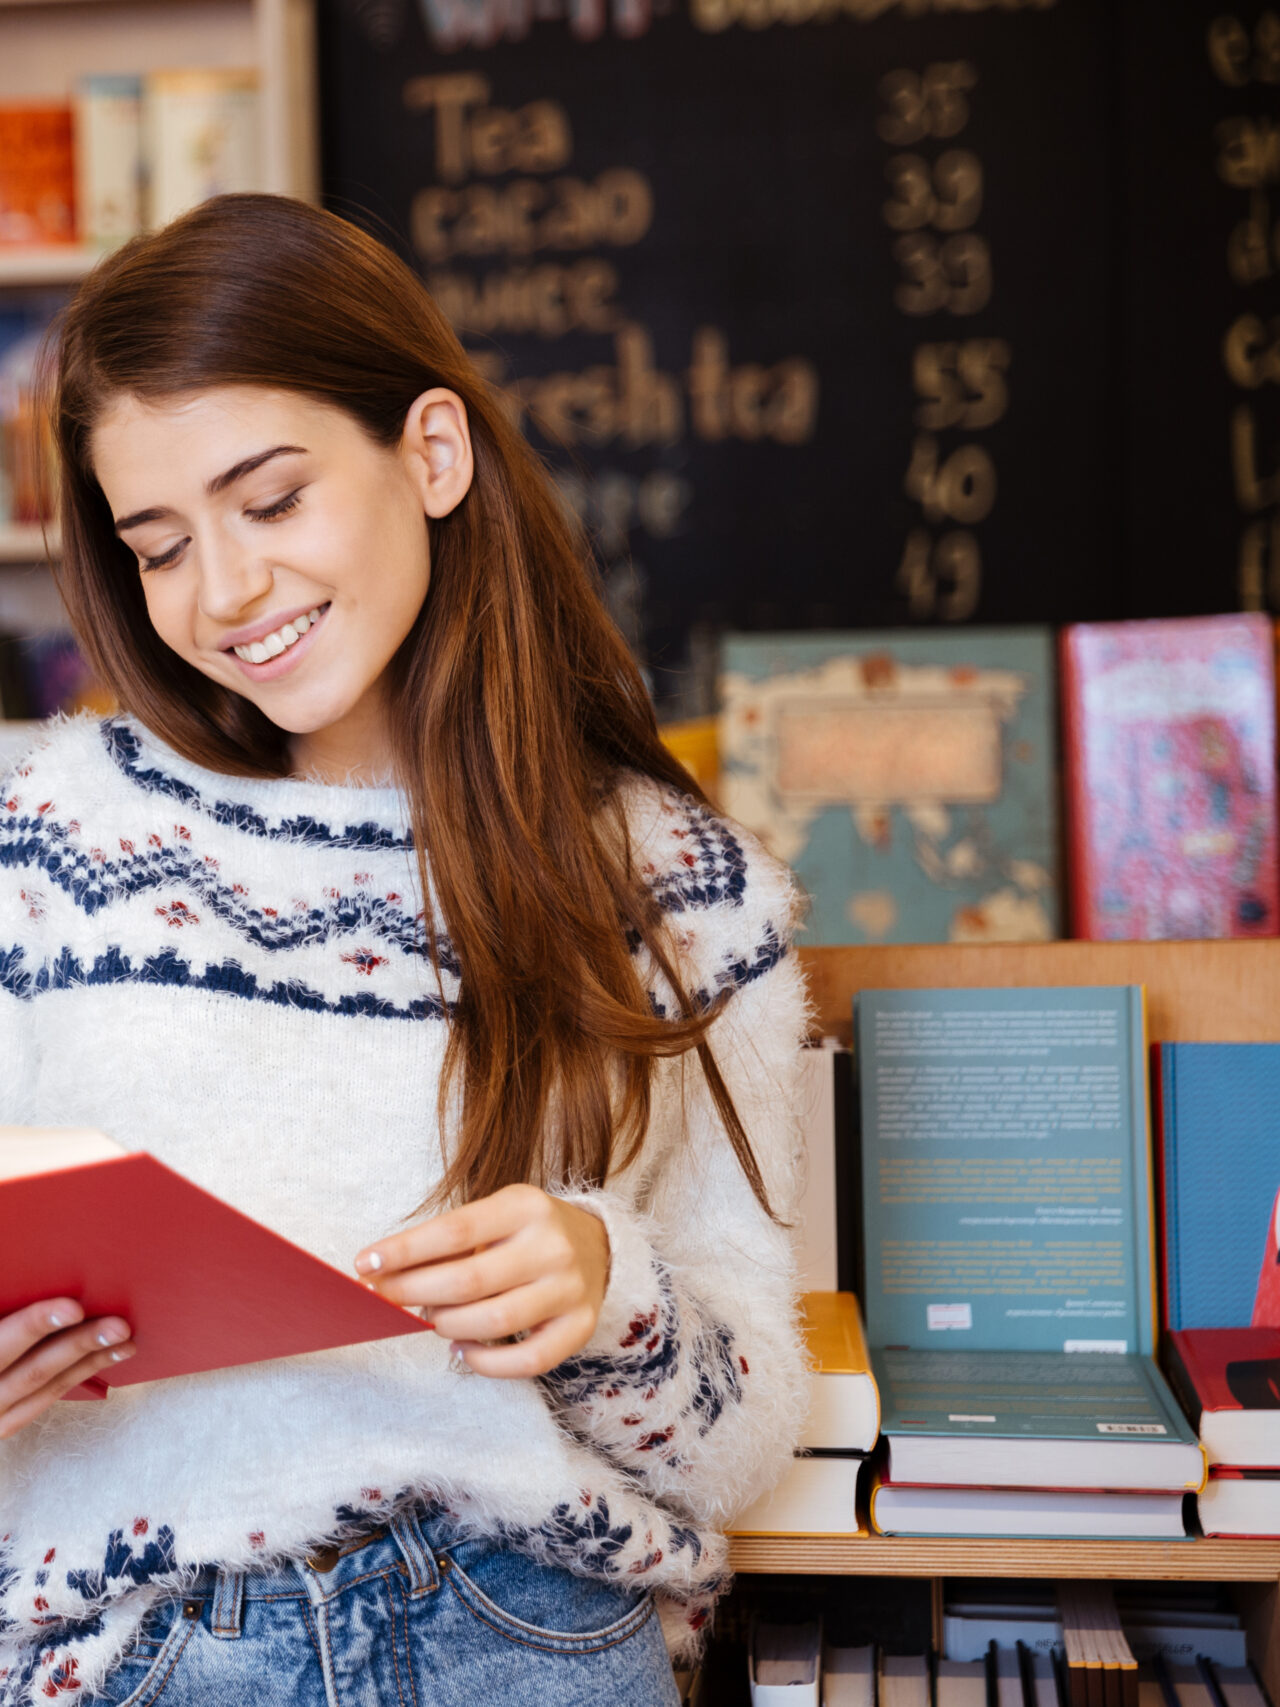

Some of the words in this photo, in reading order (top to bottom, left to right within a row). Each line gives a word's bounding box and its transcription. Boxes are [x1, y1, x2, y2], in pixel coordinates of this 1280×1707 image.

[408, 77, 568, 178] Tea
[880, 66, 974, 141] 35
[416, 172, 650, 256] cacao
[886, 153, 978, 226] 39
[897, 238, 987, 311] 39
[692, 326, 816, 444] tea
[917, 343, 1008, 426] 55
[908, 439, 993, 519] 40
[899, 532, 978, 616] 49
